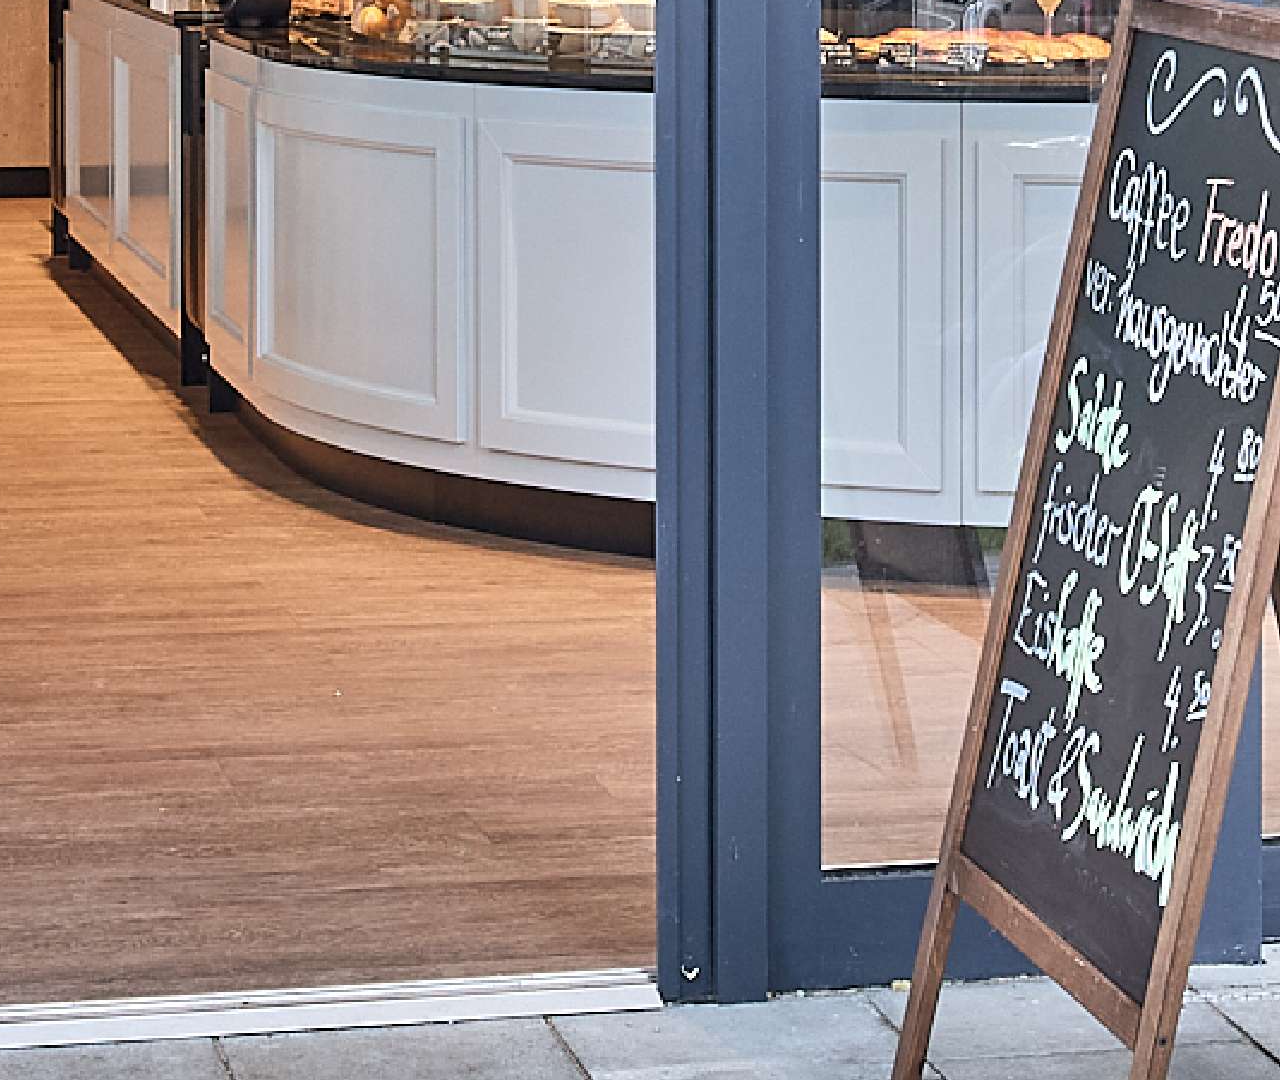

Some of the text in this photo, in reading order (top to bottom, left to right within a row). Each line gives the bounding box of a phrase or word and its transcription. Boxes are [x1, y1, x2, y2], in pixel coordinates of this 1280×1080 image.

[1197, 178, 1278, 279] Fredo
[1055, 356, 1131, 475] Salate
[986, 677, 1057, 811] Toast
